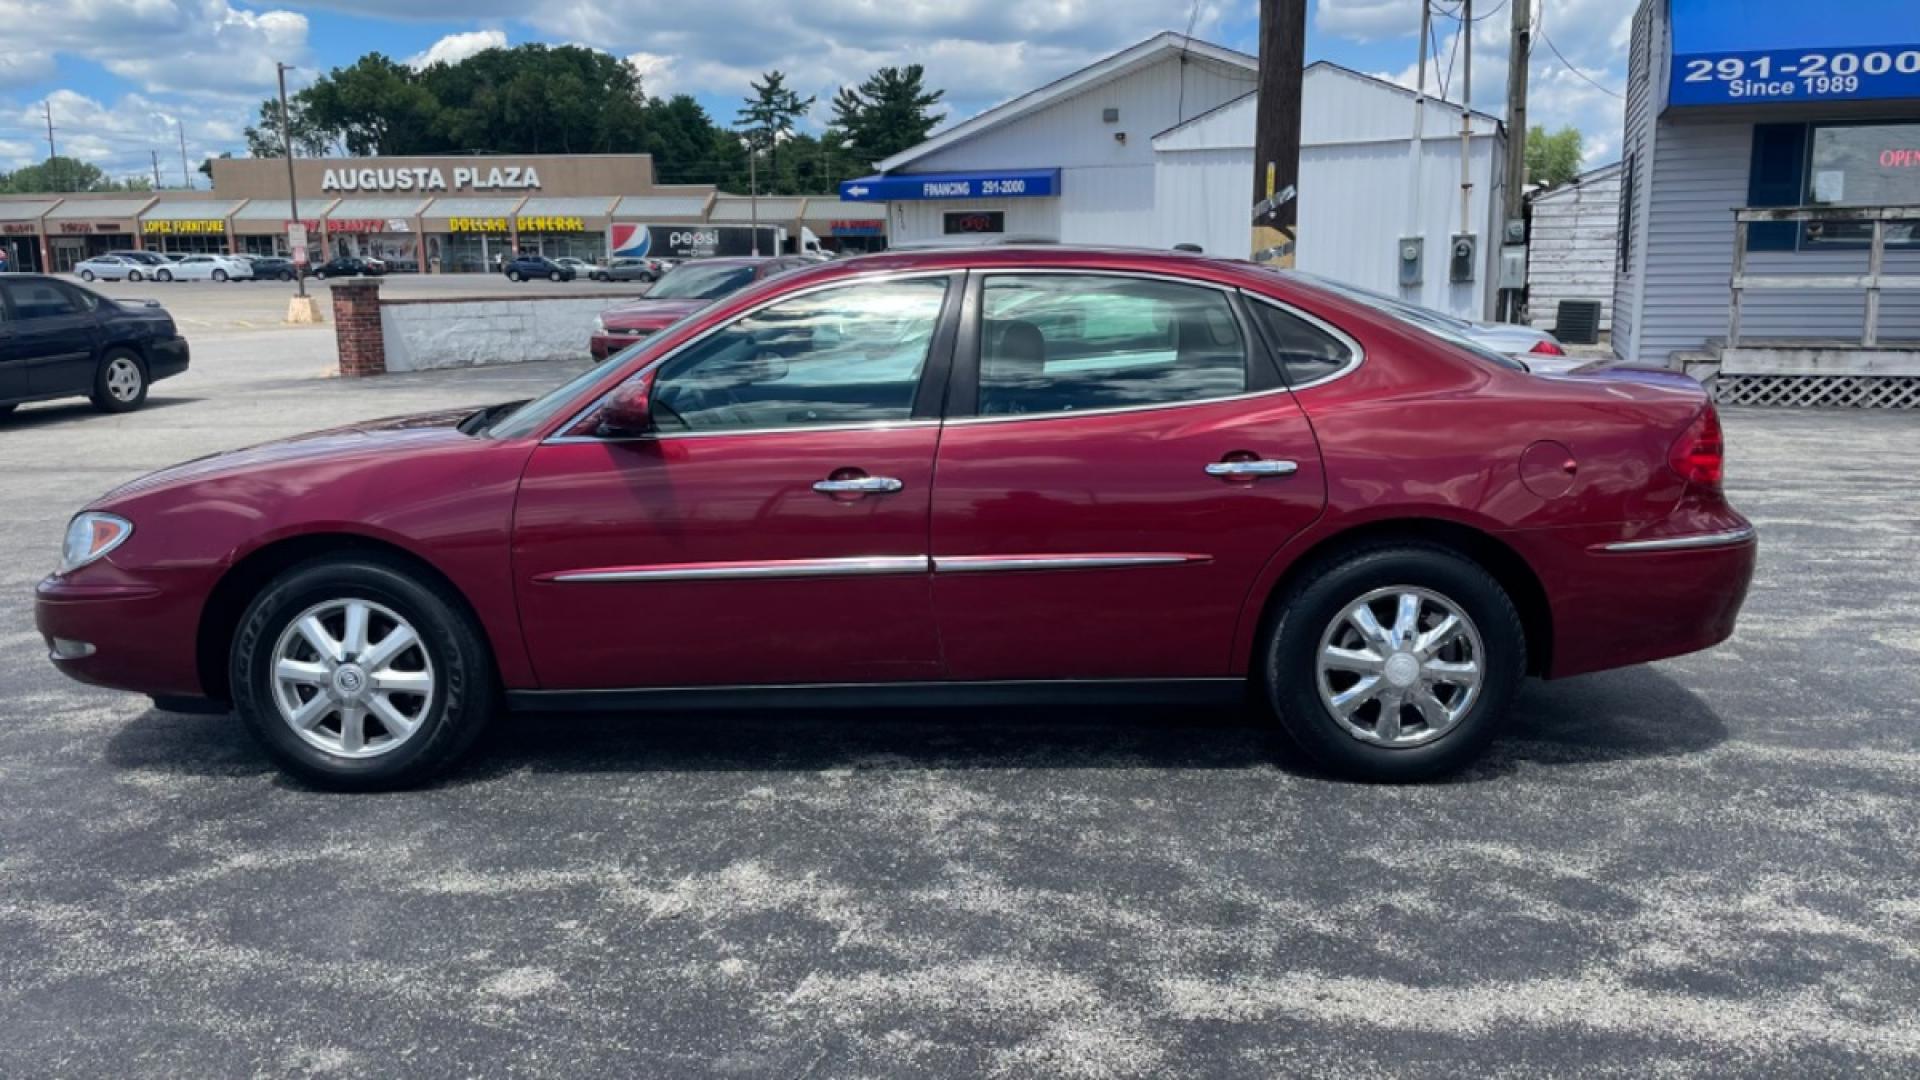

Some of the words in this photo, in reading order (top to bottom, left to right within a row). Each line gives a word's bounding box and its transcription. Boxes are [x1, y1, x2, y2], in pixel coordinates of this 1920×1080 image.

[1685, 51, 1920, 82] 291-2000
[1729, 79, 1795, 97] Since
[1803, 76, 1858, 94] 1989
[321, 168, 446, 190] AUGUSTA
[453, 167, 541, 189] PLAZA
[923, 181, 970, 196] FINANCING
[982, 180, 1025, 193] 291-2000
[173, 219, 225, 232] FURNITURE
[448, 217, 508, 233] DOLLAR
[517, 216, 585, 232] GENERAL
[669, 229, 719, 249] pepsi
